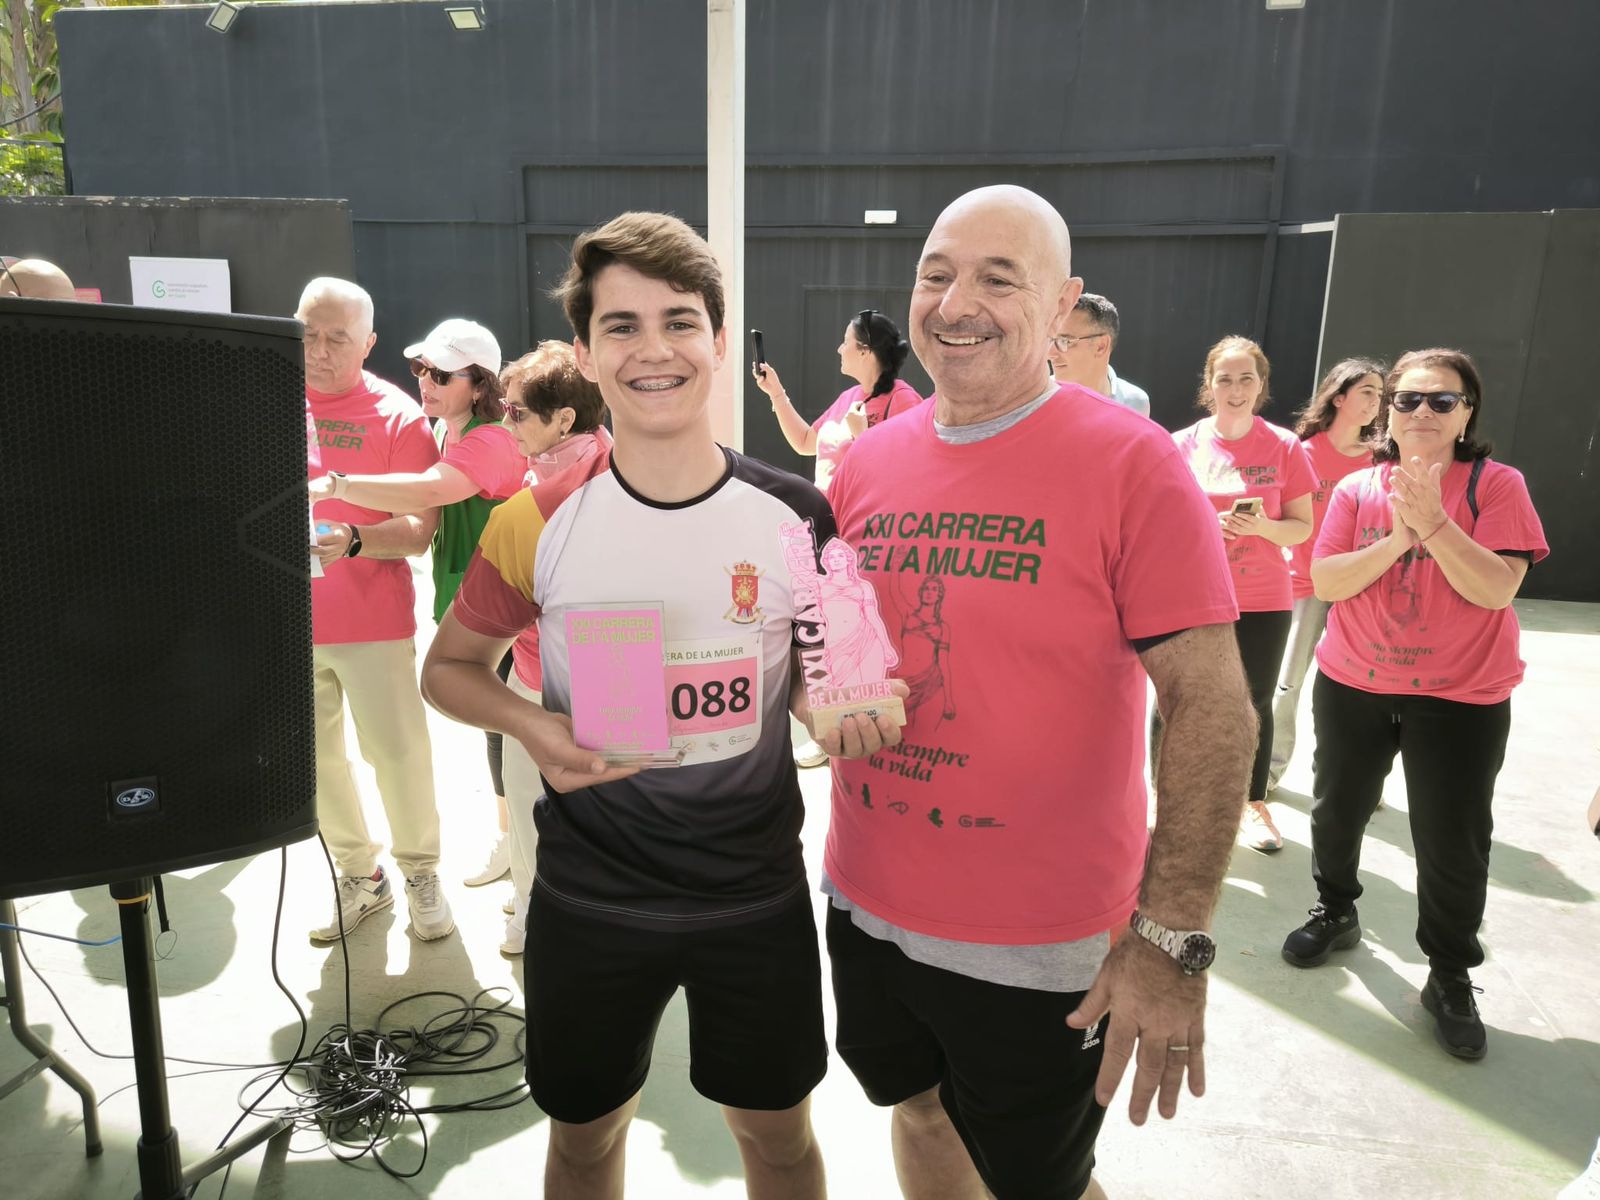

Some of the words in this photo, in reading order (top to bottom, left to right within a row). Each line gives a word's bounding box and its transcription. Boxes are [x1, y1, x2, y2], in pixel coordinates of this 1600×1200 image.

[316, 434, 363, 451] UJER
[863, 512, 896, 540] XXI
[898, 511, 1046, 547] CARRERA
[857, 545, 883, 571] DE
[884, 545, 920, 575] LA
[926, 546, 1042, 585] MUJER
[591, 615, 654, 630] CARRERA
[611, 630, 657, 644] MUJER
[686, 651, 698, 660] DE
[700, 650, 712, 659] LA
[714, 646, 744, 657] MUJER
[664, 676, 751, 720] 088
[809, 692, 826, 708] DE
[828, 689, 845, 706] LA
[849, 681, 893, 703] MUJER
[868, 754, 884, 770] la
[888, 759, 933, 782] vida
